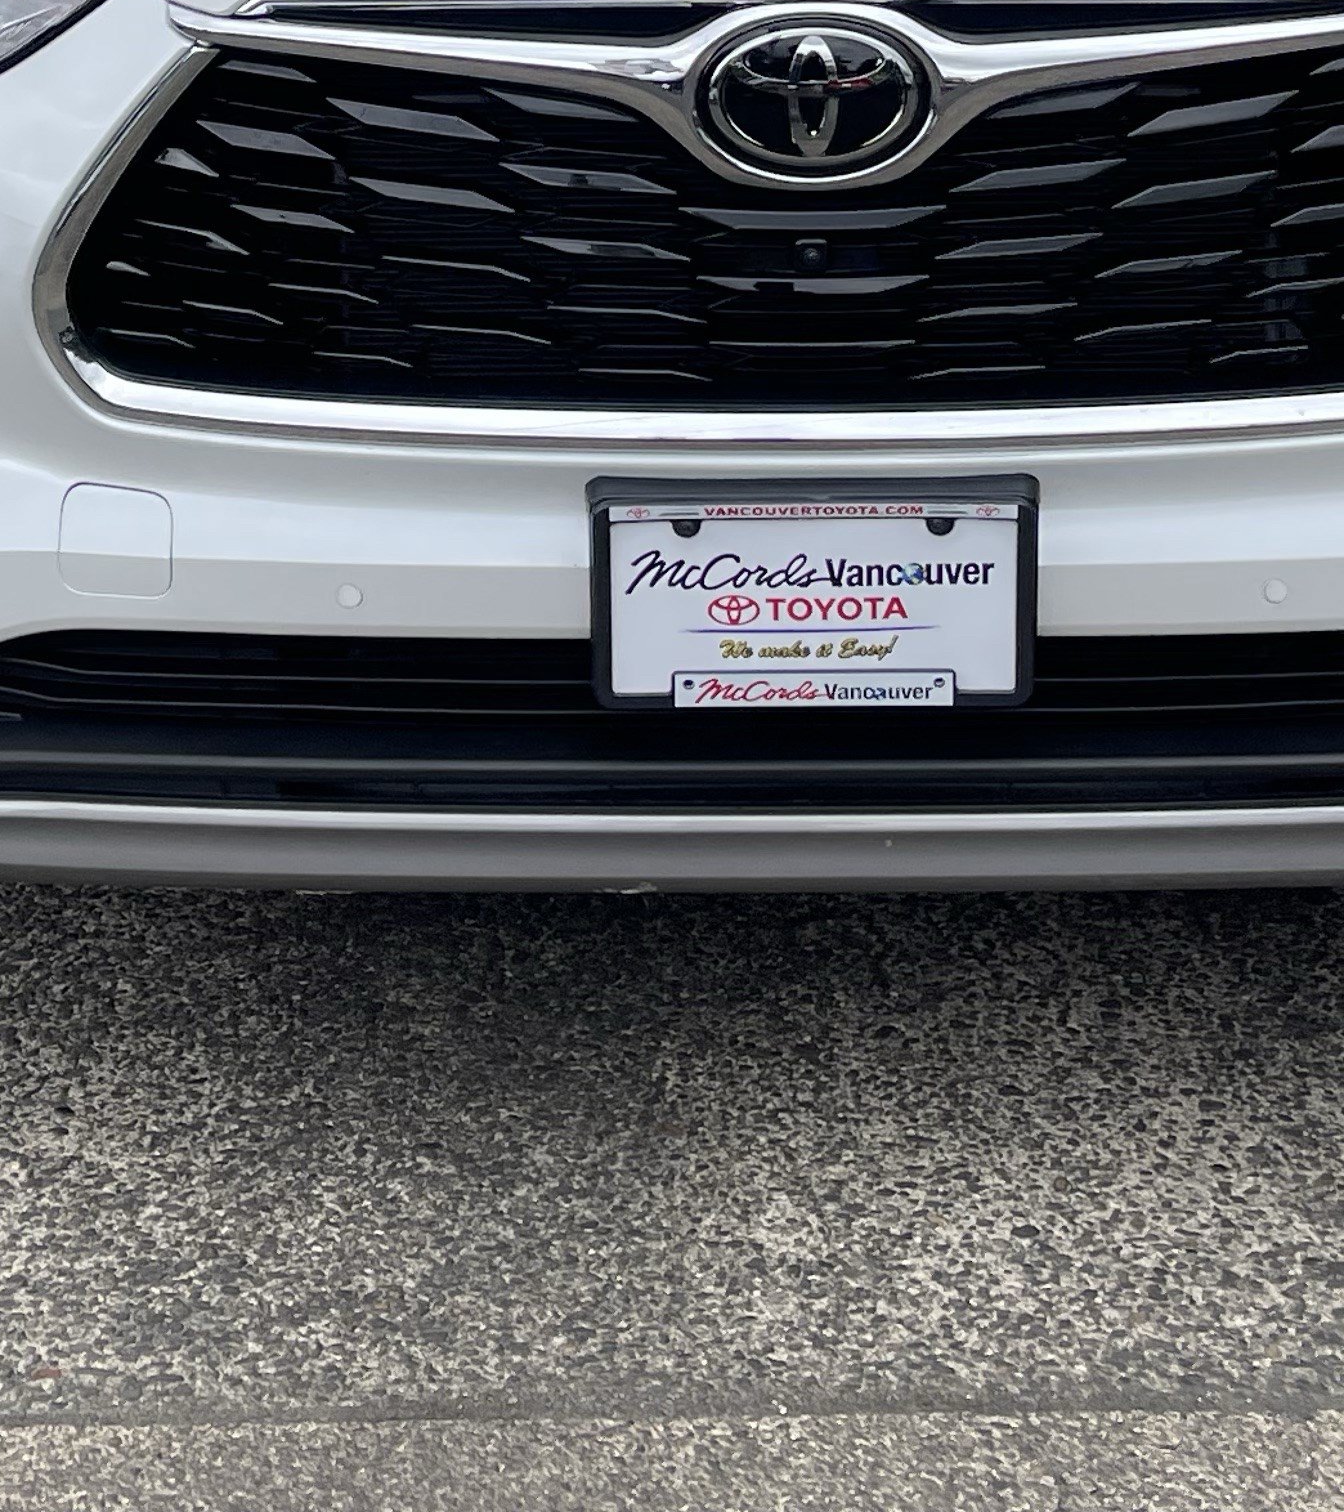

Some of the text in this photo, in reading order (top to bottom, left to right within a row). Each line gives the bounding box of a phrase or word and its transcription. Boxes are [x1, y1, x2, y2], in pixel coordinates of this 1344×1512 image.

[765, 596, 908, 621] TOYOTA
[719, 635, 900, 661] We make it Easy!
